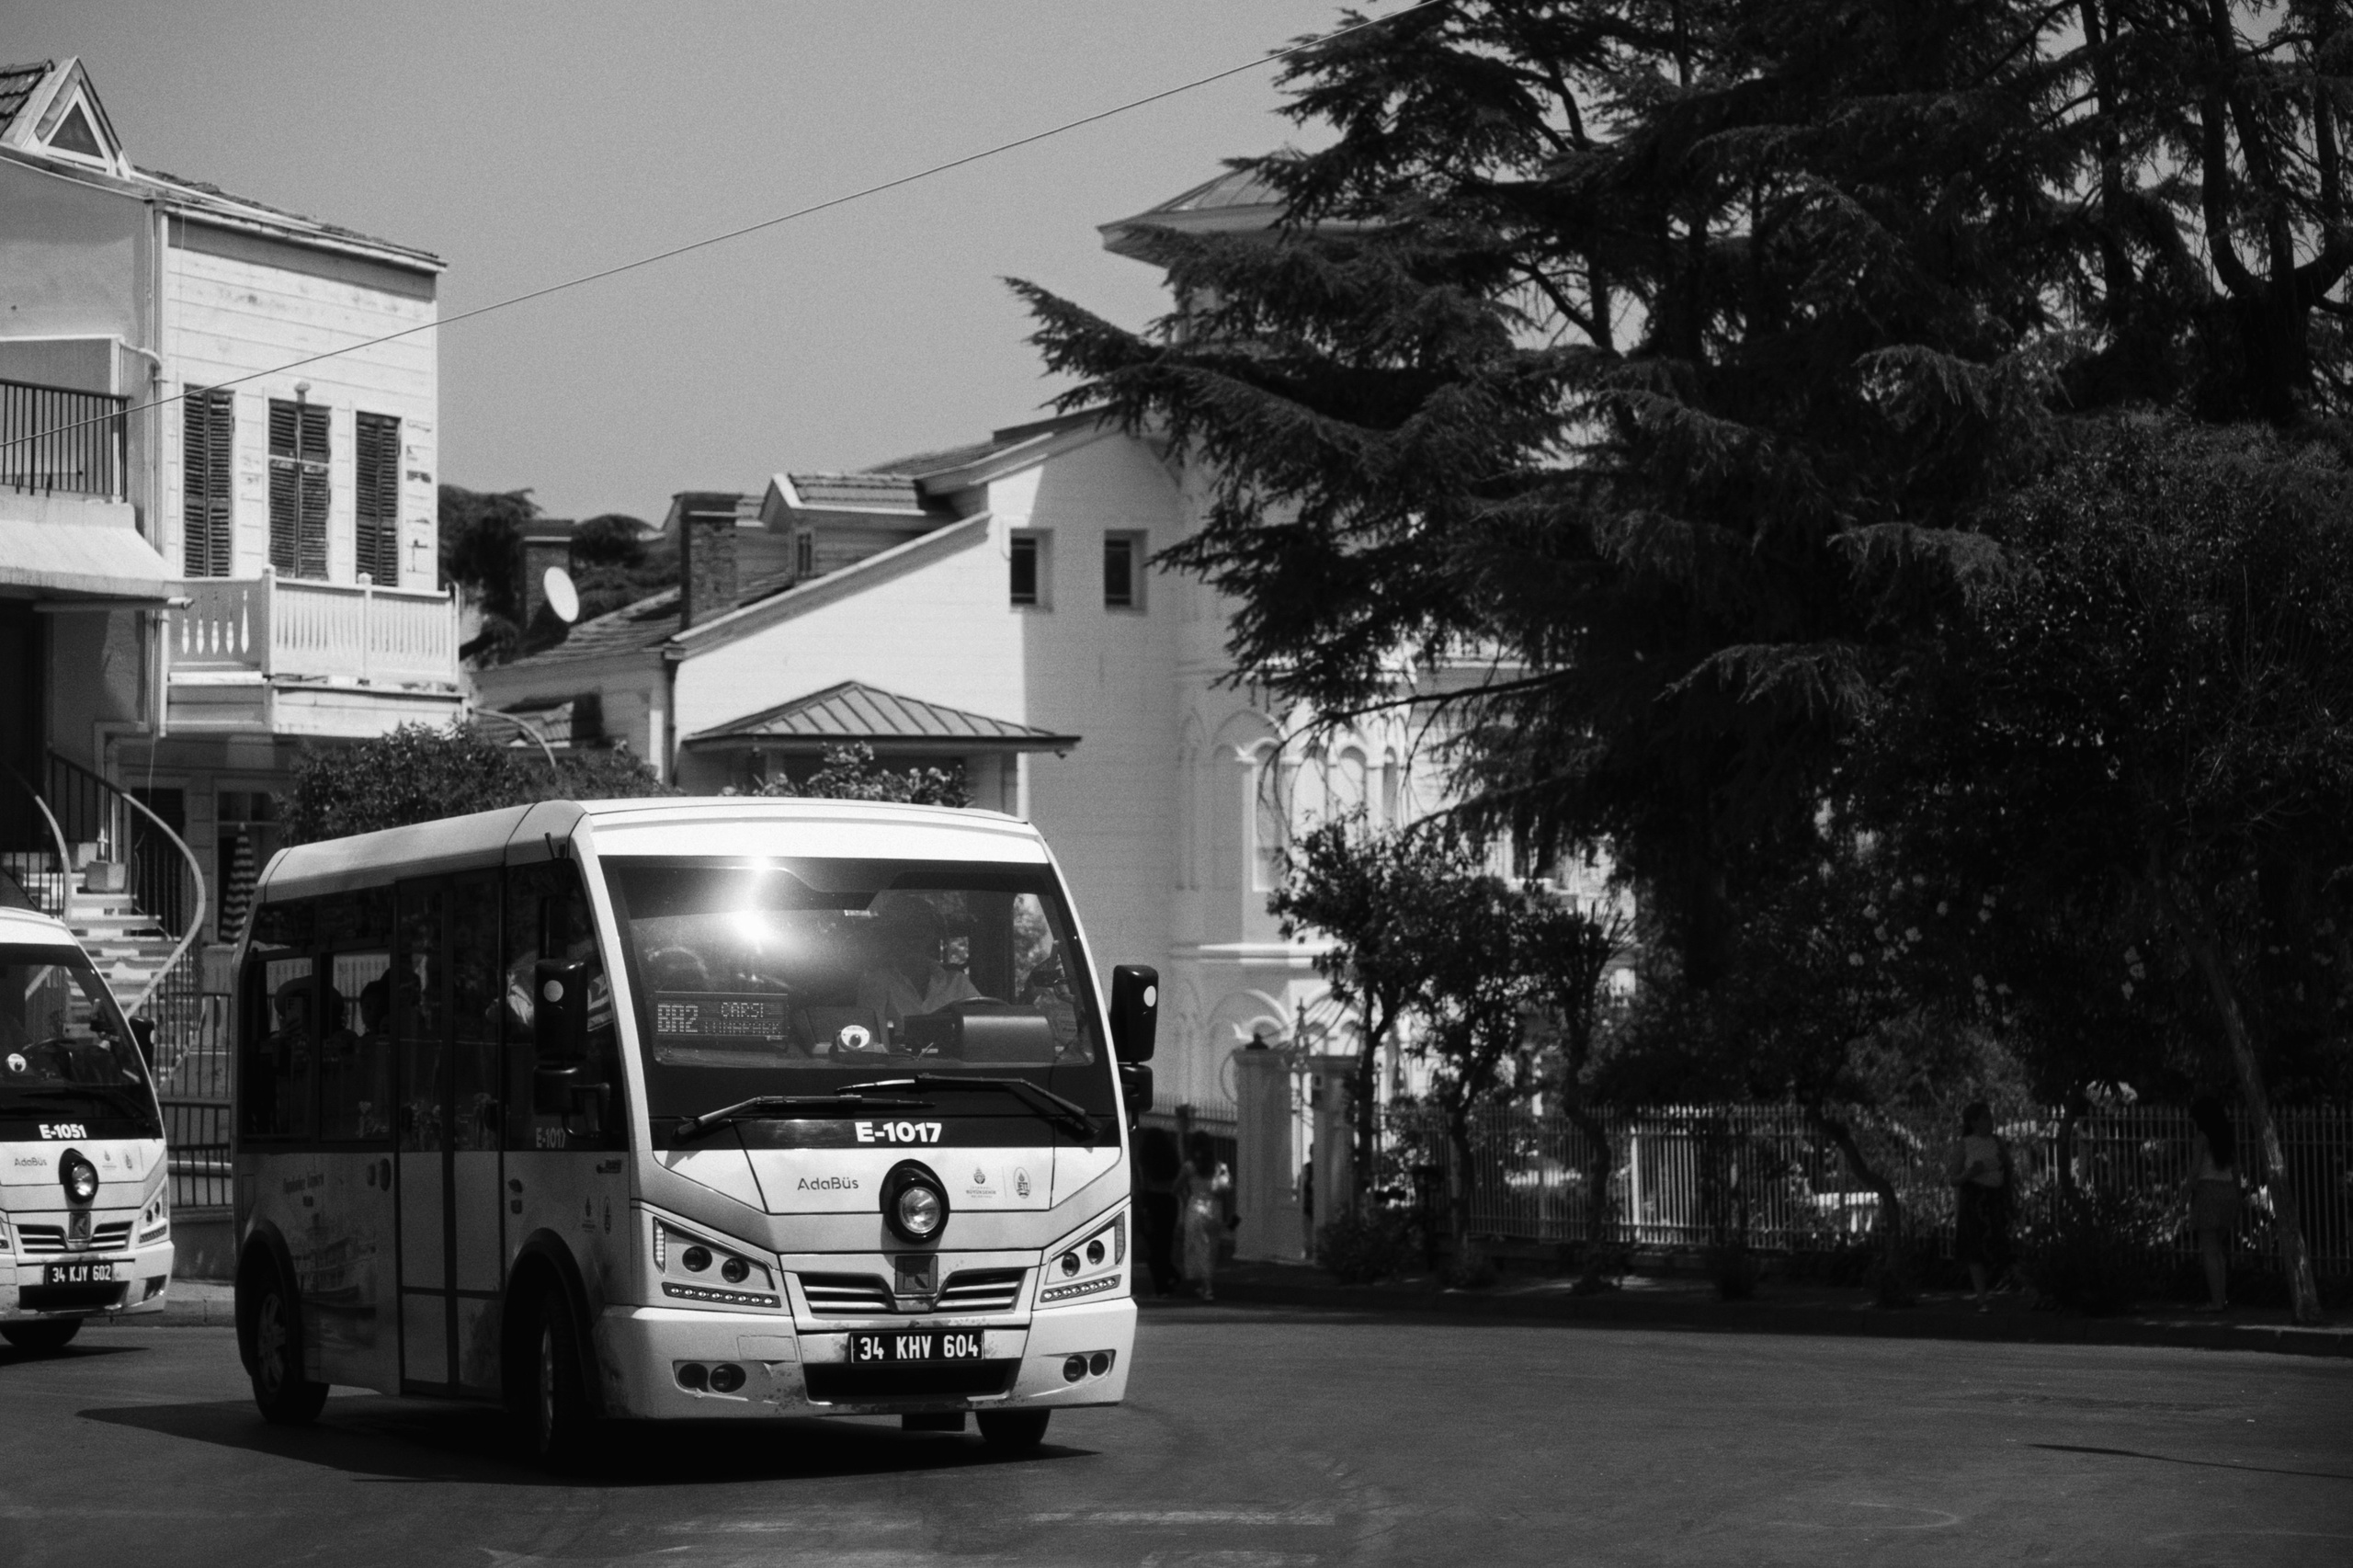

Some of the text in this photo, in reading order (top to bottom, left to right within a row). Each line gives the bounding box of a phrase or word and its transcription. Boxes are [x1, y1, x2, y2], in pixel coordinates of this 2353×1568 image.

[657, 1003, 699, 1033] BA2
[39, 1123, 87, 1139] E-1051
[536, 1127, 566, 1148] E-1017
[855, 1121, 942, 1142] E-1017
[14, 1157, 48, 1166] AdaBüs
[797, 1176, 859, 1191] AdaBüs
[52, 1265, 111, 1283] 34 KJY 602
[859, 1334, 979, 1360] 34 KHV 604
